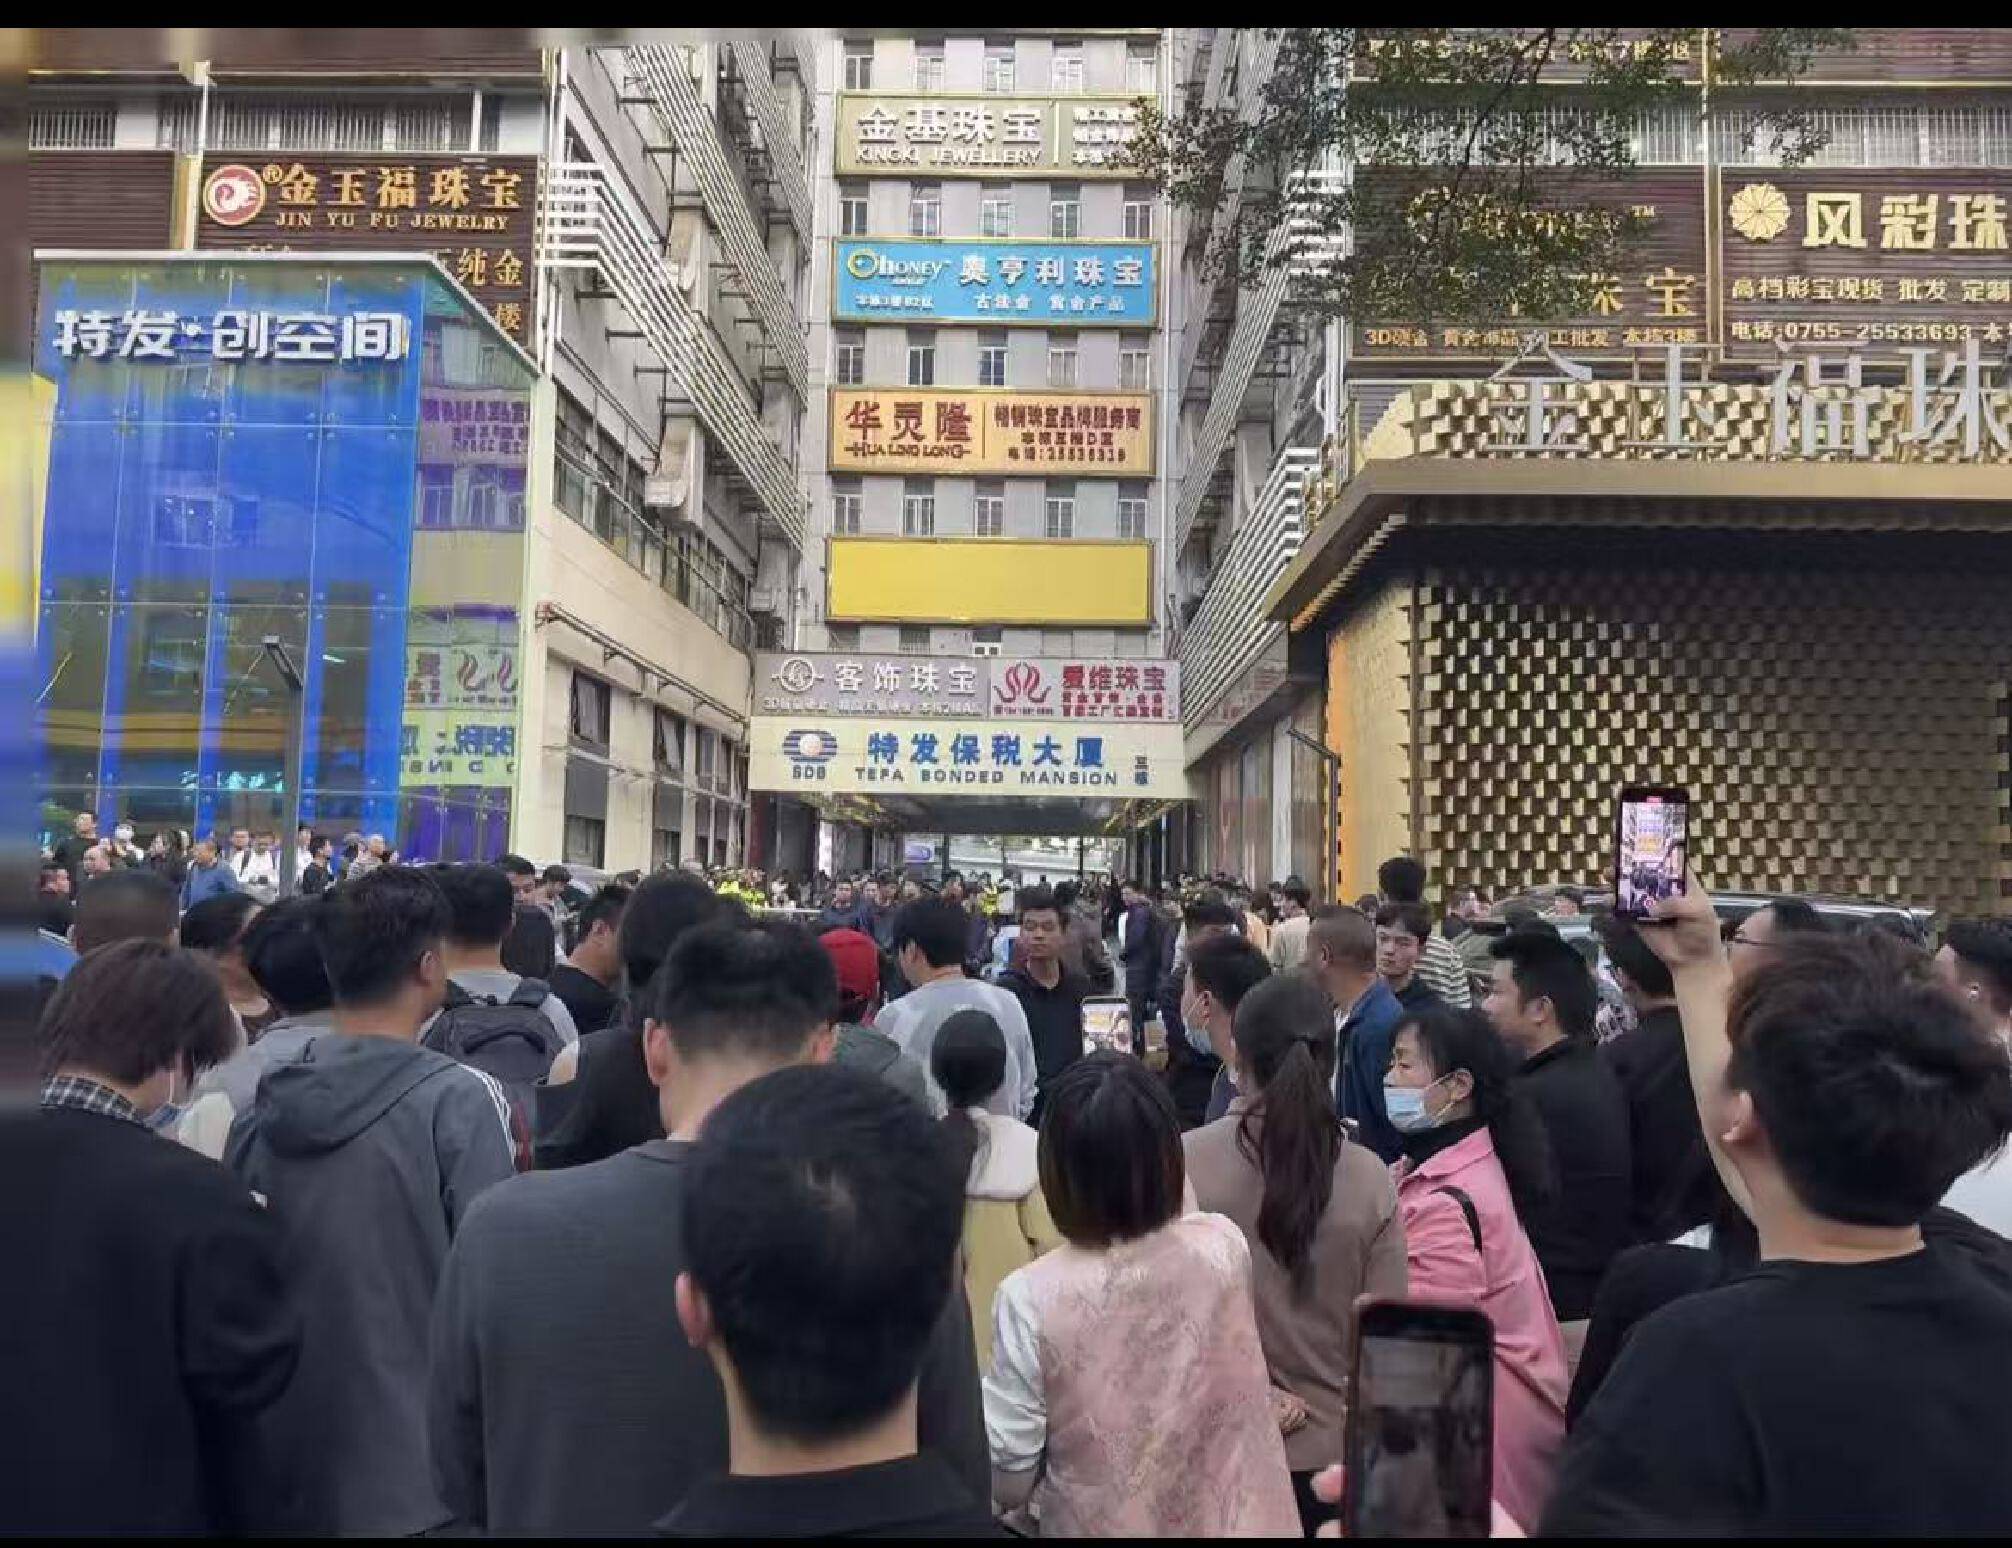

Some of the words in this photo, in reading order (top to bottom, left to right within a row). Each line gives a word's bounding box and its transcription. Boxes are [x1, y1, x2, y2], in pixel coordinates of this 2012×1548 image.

[857, 103, 1041, 146] 金基珠宝
[930, 148, 1041, 167] JEWELLERY
[277, 163, 523, 209] 金玉福珠宝
[275, 212, 312, 228] JIN
[327, 212, 355, 228] YU
[370, 212, 400, 229] FU
[411, 213, 510, 231] JEWELRY
[1801, 192, 2009, 250] 风彩珠
[960, 254, 1143, 288] 奥亨利珠宝
[1732, 275, 1884, 301] 高档彩宝现货
[1898, 276, 1948, 301] 批发
[845, 400, 973, 442] 华灵隆
[834, 660, 977, 698] 客饰珠宝
[867, 730, 1105, 768] 特发保税大厦
[855, 767, 905, 782] TEFA
[921, 768, 1004, 785] BONDED
[1020, 770, 1117, 786] MANSION
